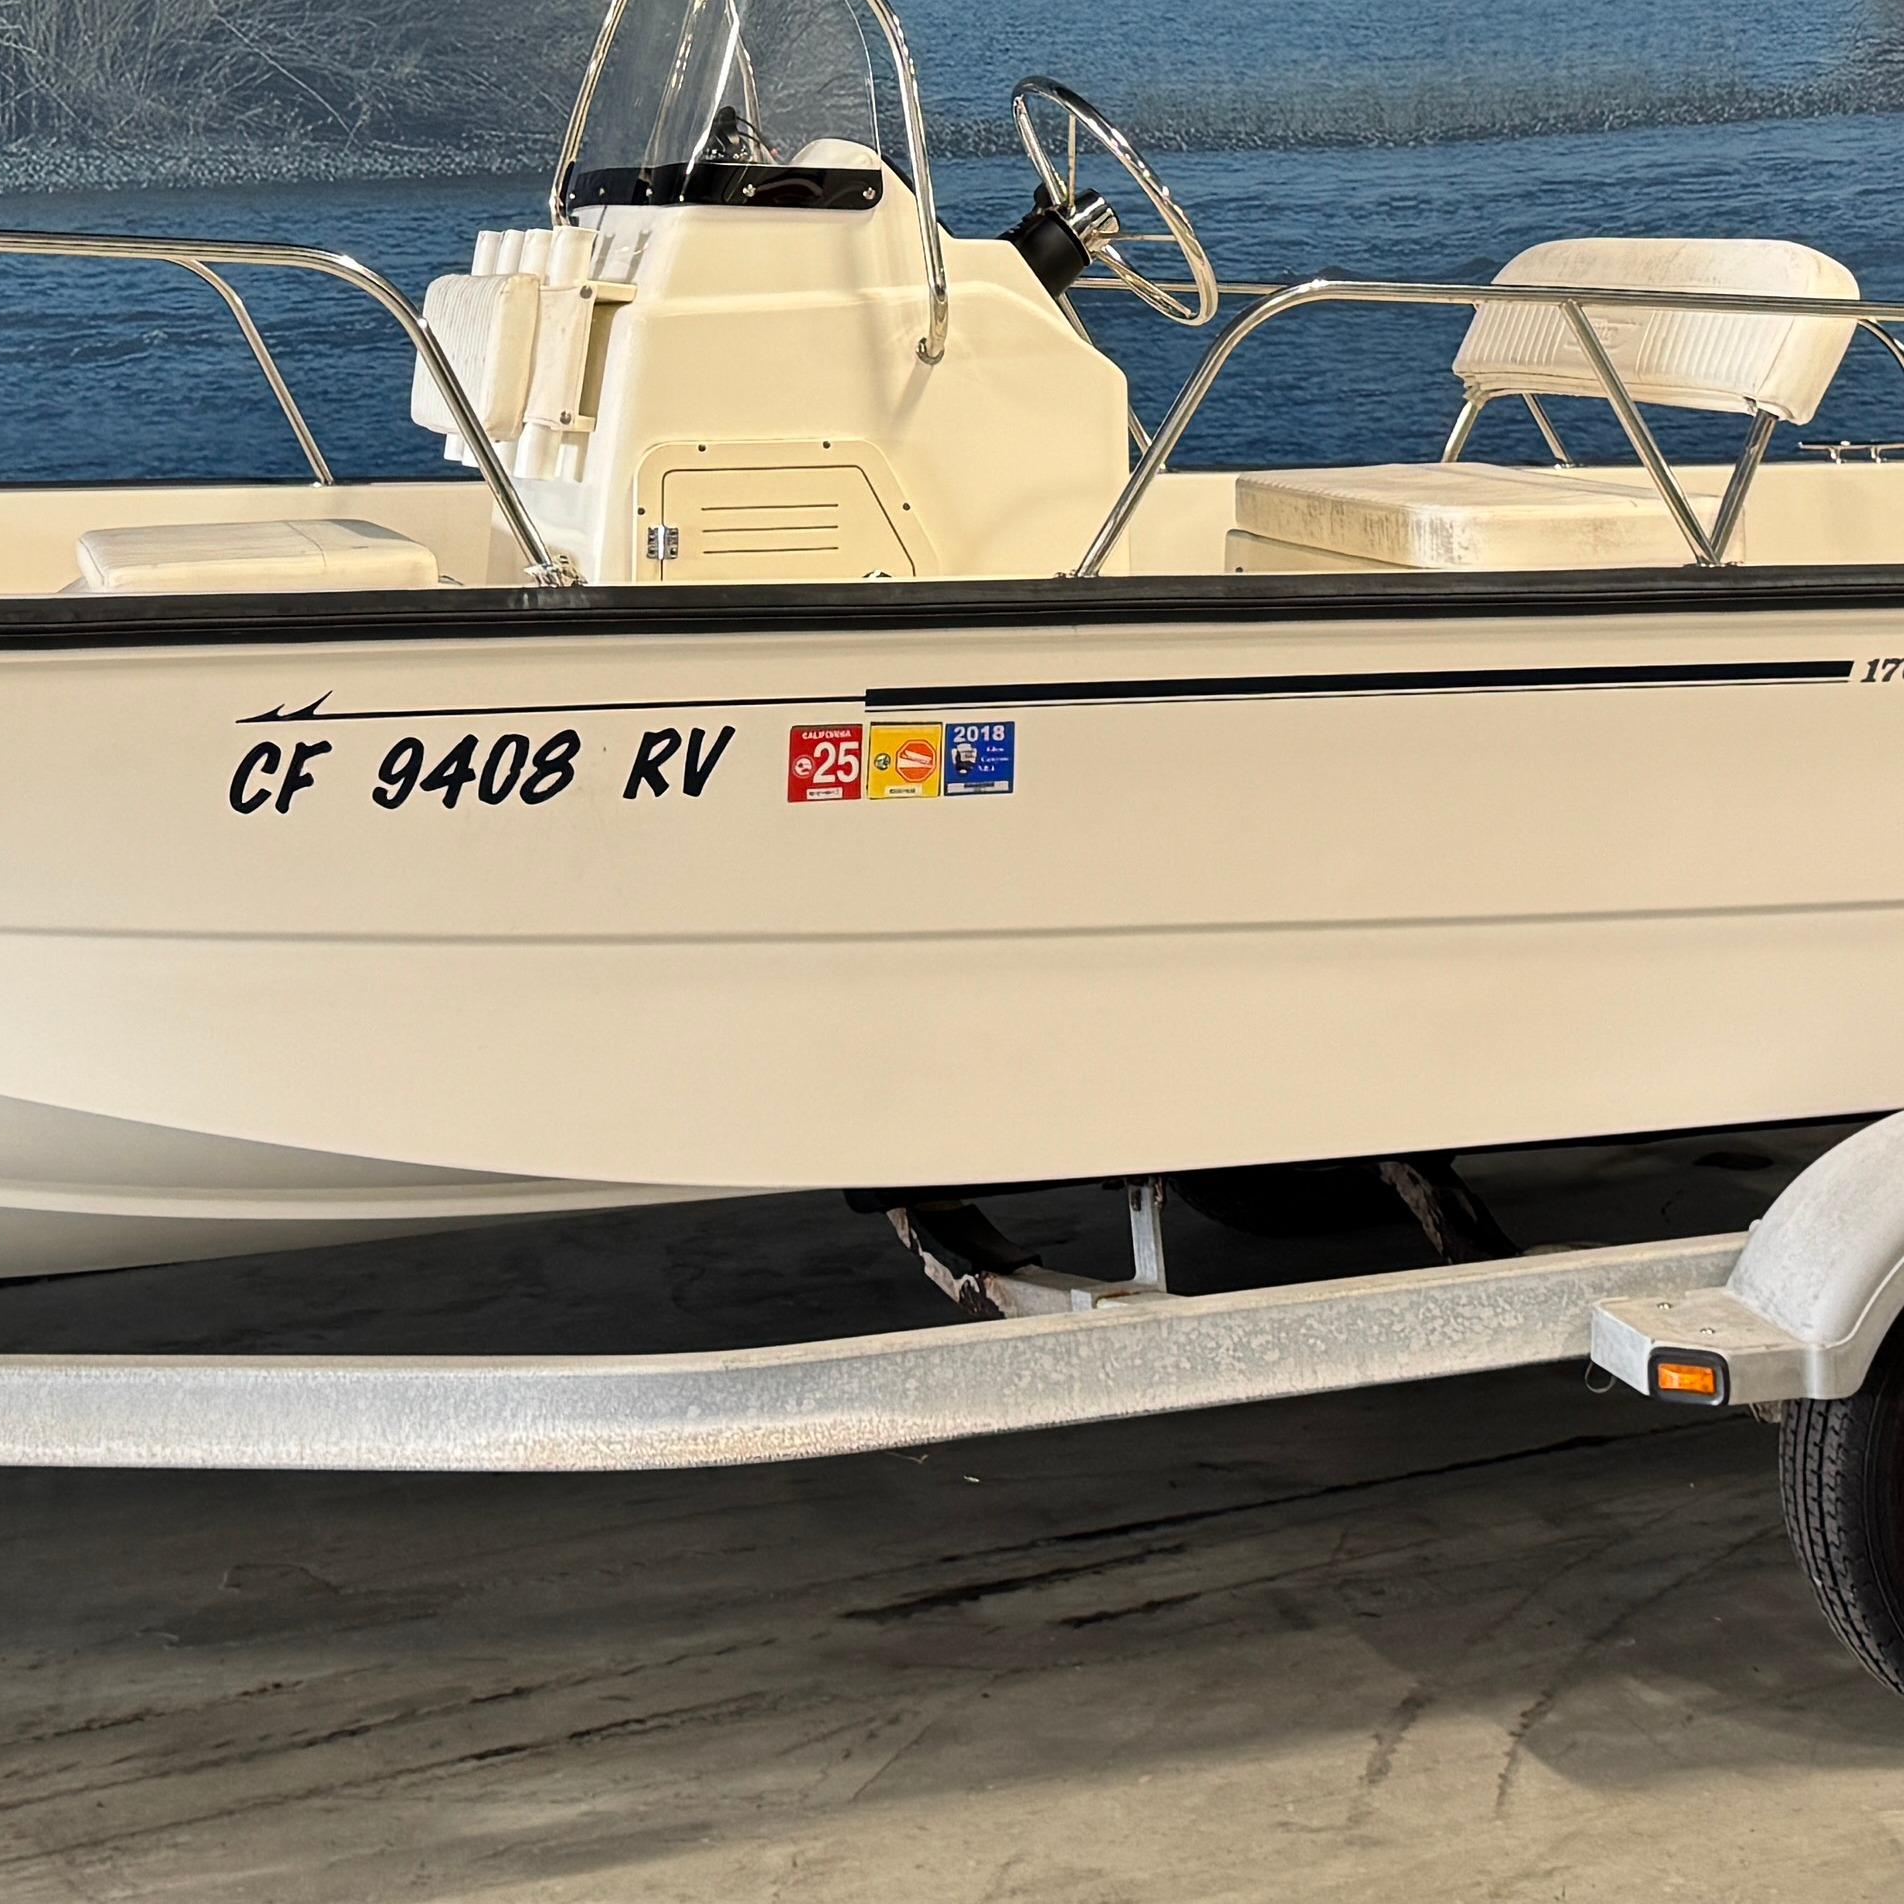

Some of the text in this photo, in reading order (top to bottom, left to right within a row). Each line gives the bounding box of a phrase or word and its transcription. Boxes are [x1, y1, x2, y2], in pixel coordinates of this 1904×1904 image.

[953, 724, 1006, 743] 2018
[229, 725, 736, 815] CF 9408 RV
[812, 740, 861, 784] 25
